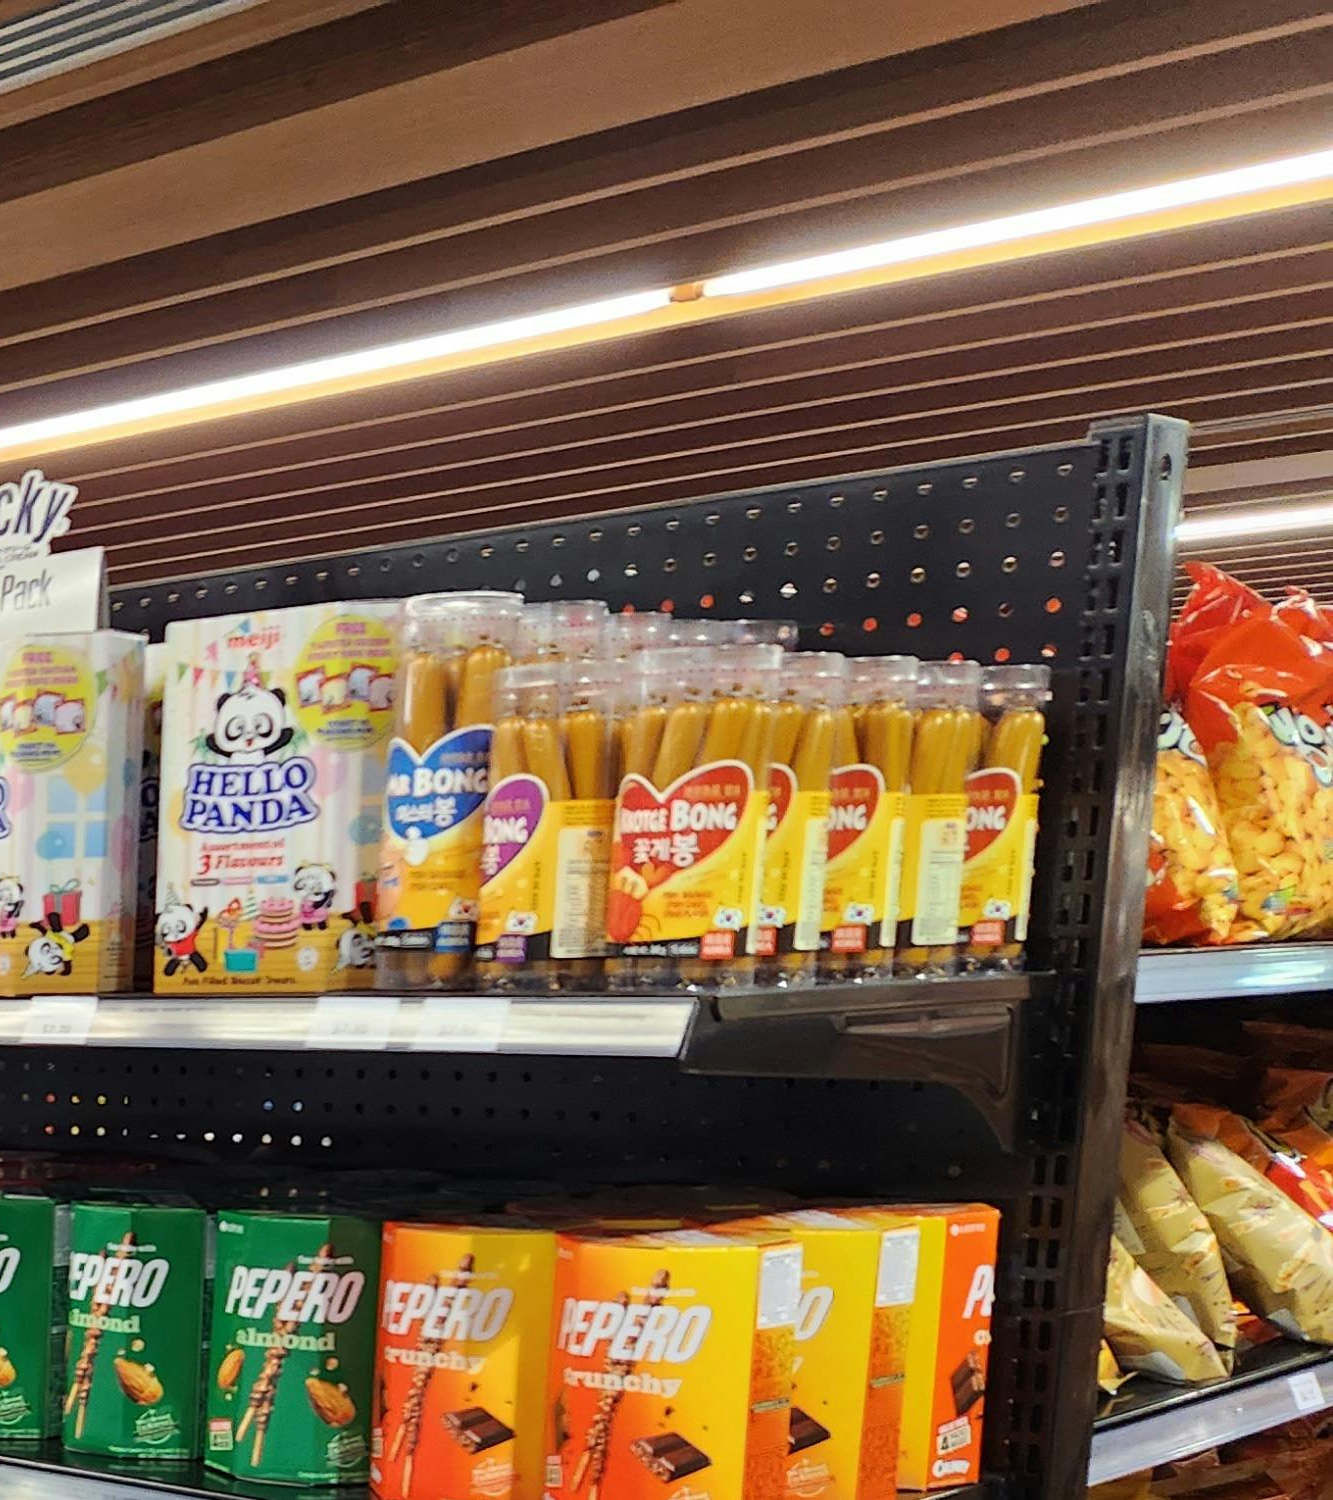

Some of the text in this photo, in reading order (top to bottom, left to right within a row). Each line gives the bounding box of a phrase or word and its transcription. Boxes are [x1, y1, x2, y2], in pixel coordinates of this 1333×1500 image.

[0, 570, 53, 614] Pack
[227, 626, 281, 651] meiji
[190, 762, 309, 799] HELLO
[413, 767, 487, 797] BONG
[185, 795, 313, 828] PANDA
[671, 800, 738, 832] BONG
[197, 852, 285, 876] 3 Flavours
[69, 1250, 170, 1308] EPERO
[224, 1264, 366, 1325] PEPERO
[382, 1278, 514, 1345] PEPERO
[236, 1328, 336, 1352] almond
[560, 1296, 713, 1365] PEPERO
